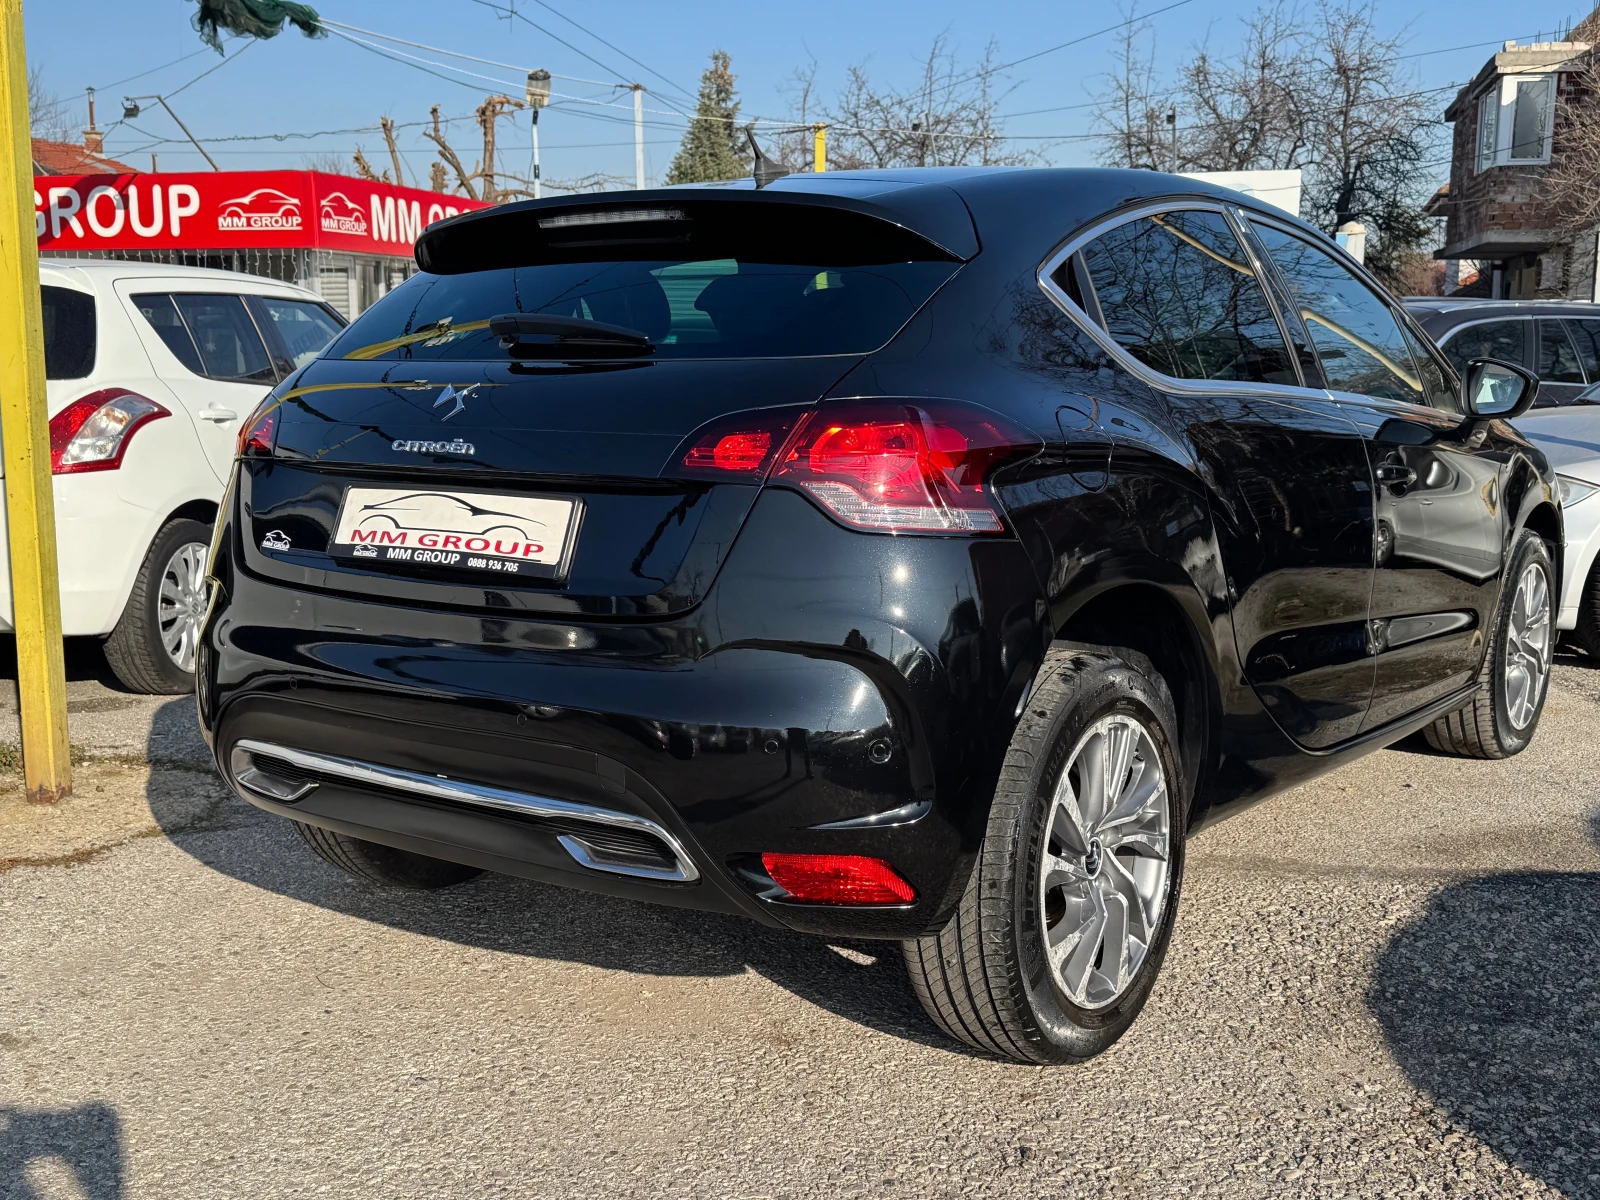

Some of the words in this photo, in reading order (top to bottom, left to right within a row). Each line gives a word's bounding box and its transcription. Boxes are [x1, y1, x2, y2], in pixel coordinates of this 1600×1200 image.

[218, 216, 247, 228] MM
[250, 216, 302, 228] GROUP
[321, 217, 338, 230] MM
[339, 219, 367, 233] GROUP
[370, 193, 422, 245] MM
[350, 529, 408, 545] MM
[418, 533, 544, 557] GROUP
[386, 547, 412, 560] MM
[413, 549, 460, 565] GROUP
[467, 557, 487, 568] 0888
[488, 560, 502, 570] 936
[503, 562, 519, 572] 705
